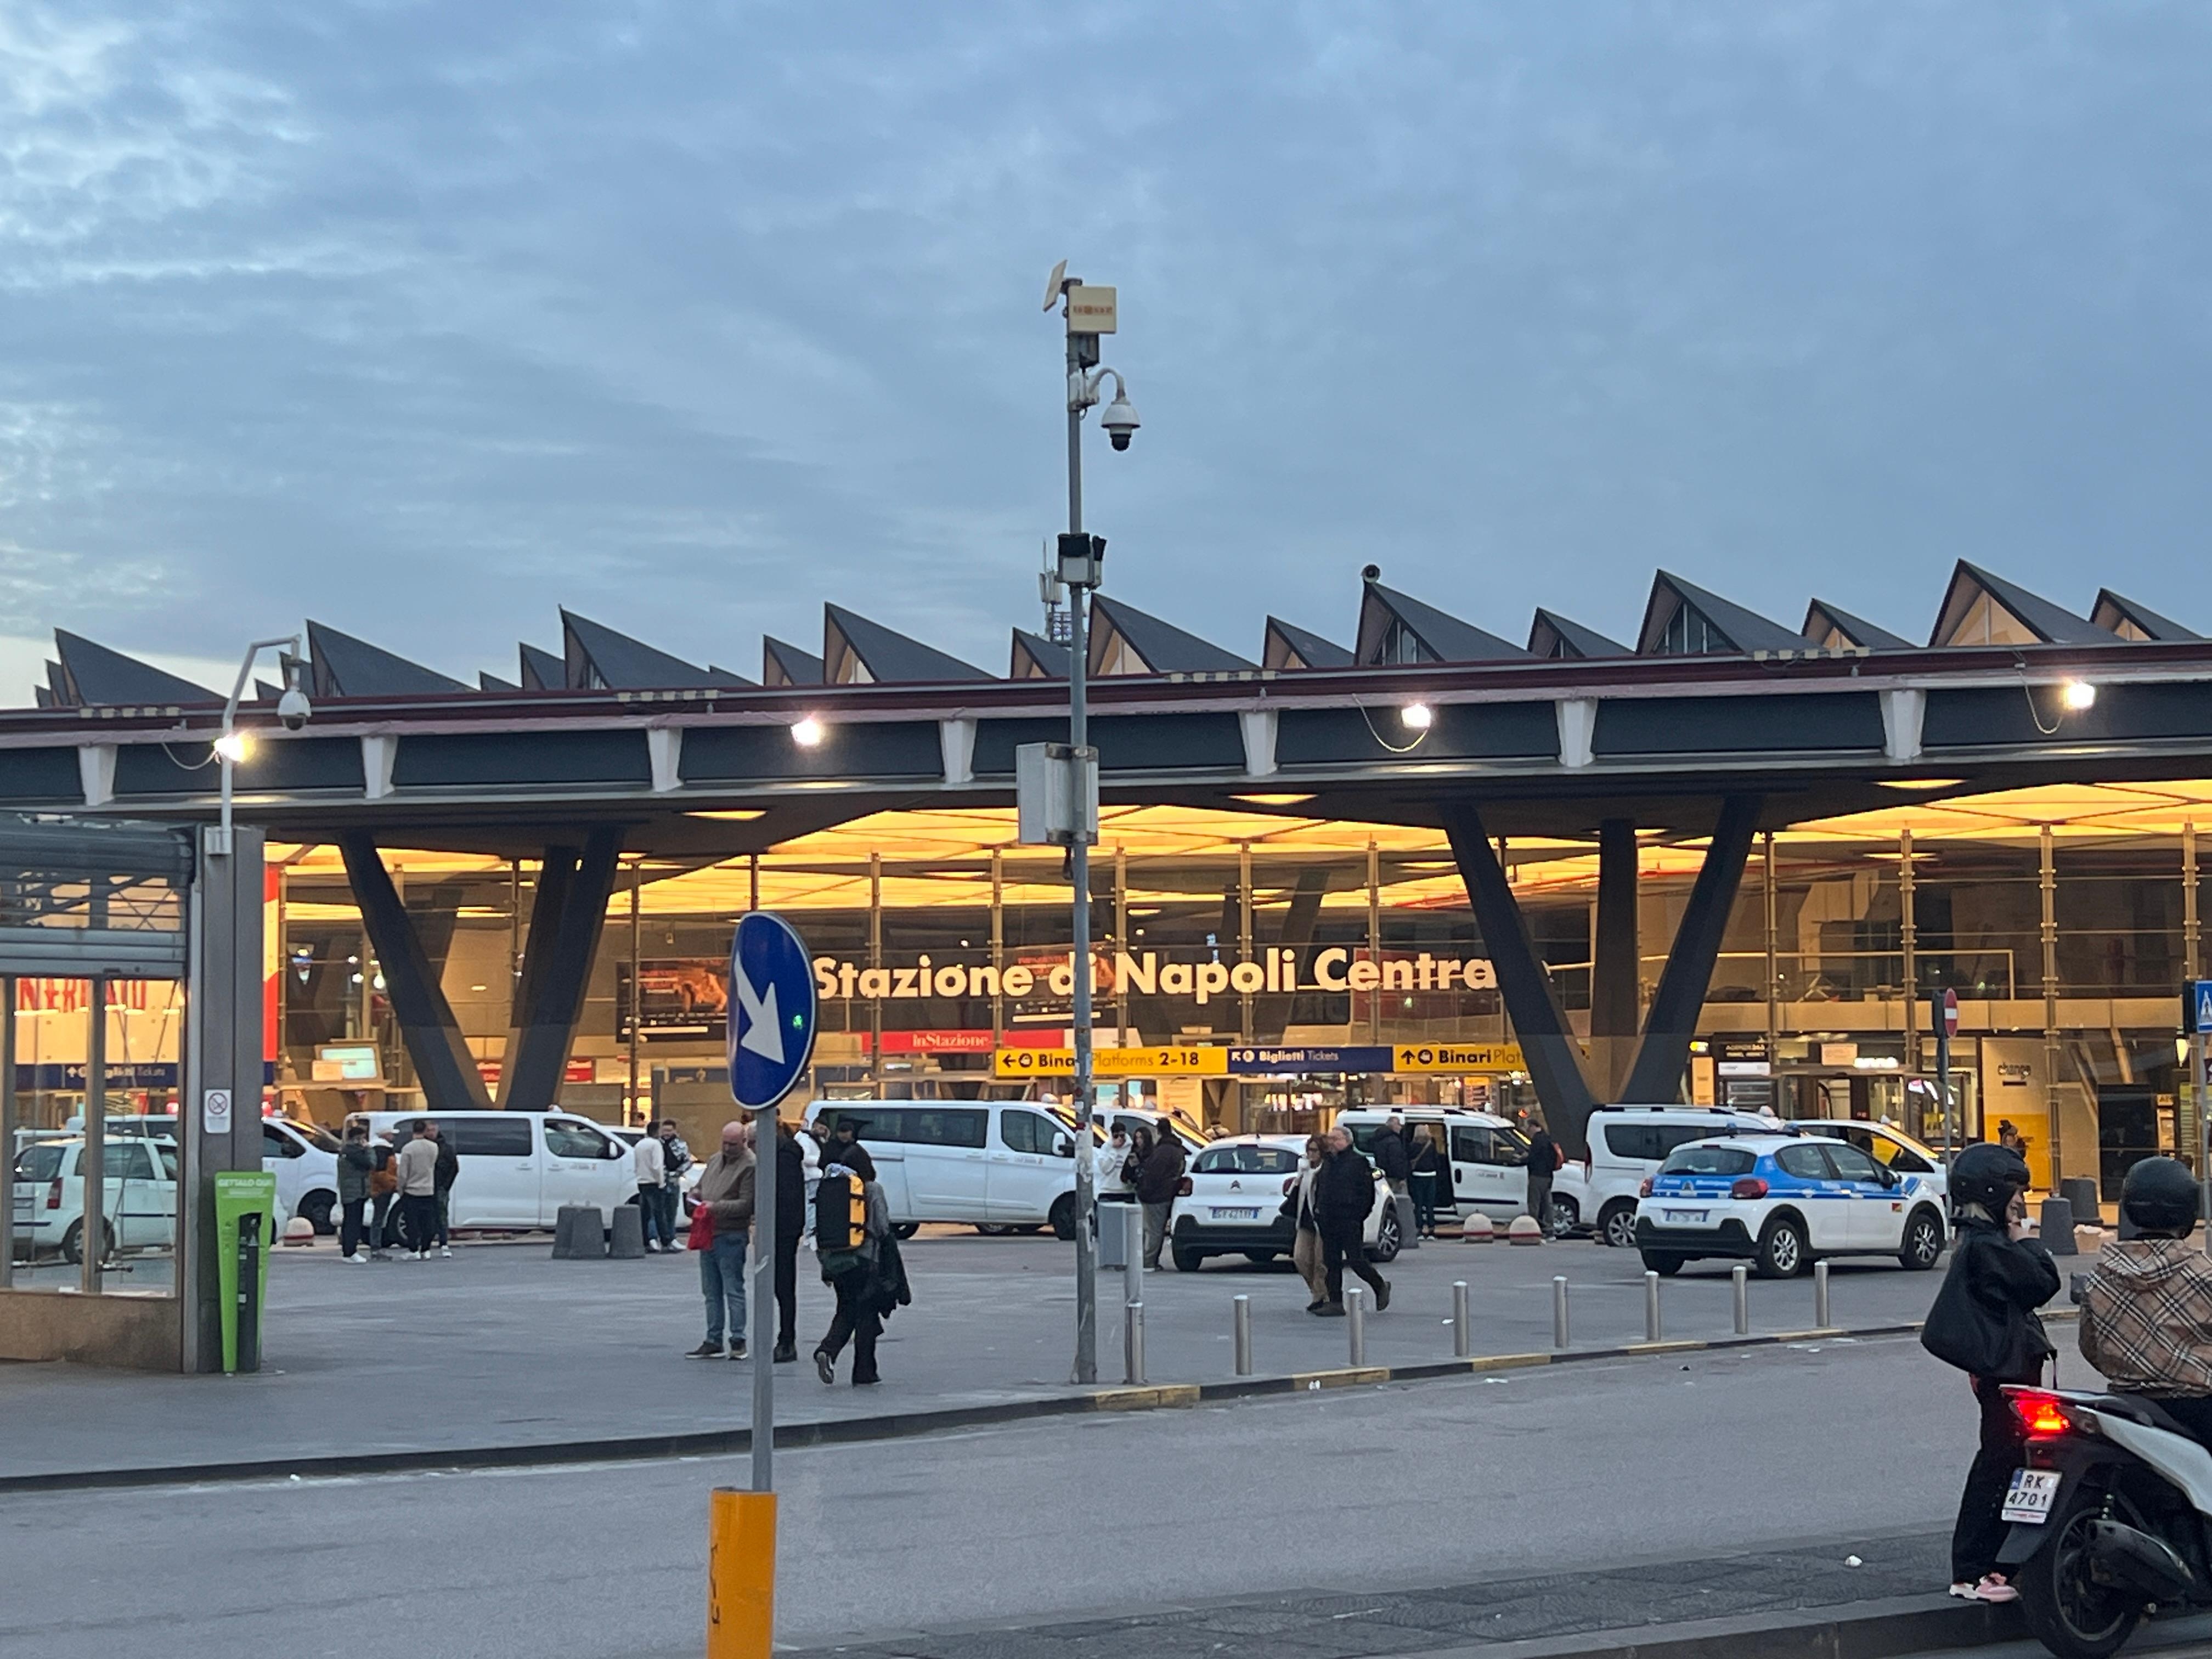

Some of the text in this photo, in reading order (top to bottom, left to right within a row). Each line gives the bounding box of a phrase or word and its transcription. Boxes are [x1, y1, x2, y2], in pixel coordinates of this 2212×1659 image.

[812, 947, 1497, 1005] Stazione di Napoli Centra
[1039, 1052, 1199, 1068] Bina Platforms 2-18
[1259, 1049, 1340, 1064] Biglietti Tickets
[1438, 1048, 1522, 1064] Binari Plat
[2023, 1474, 2045, 1489] RK
[2008, 1491, 2049, 1507] 4701
